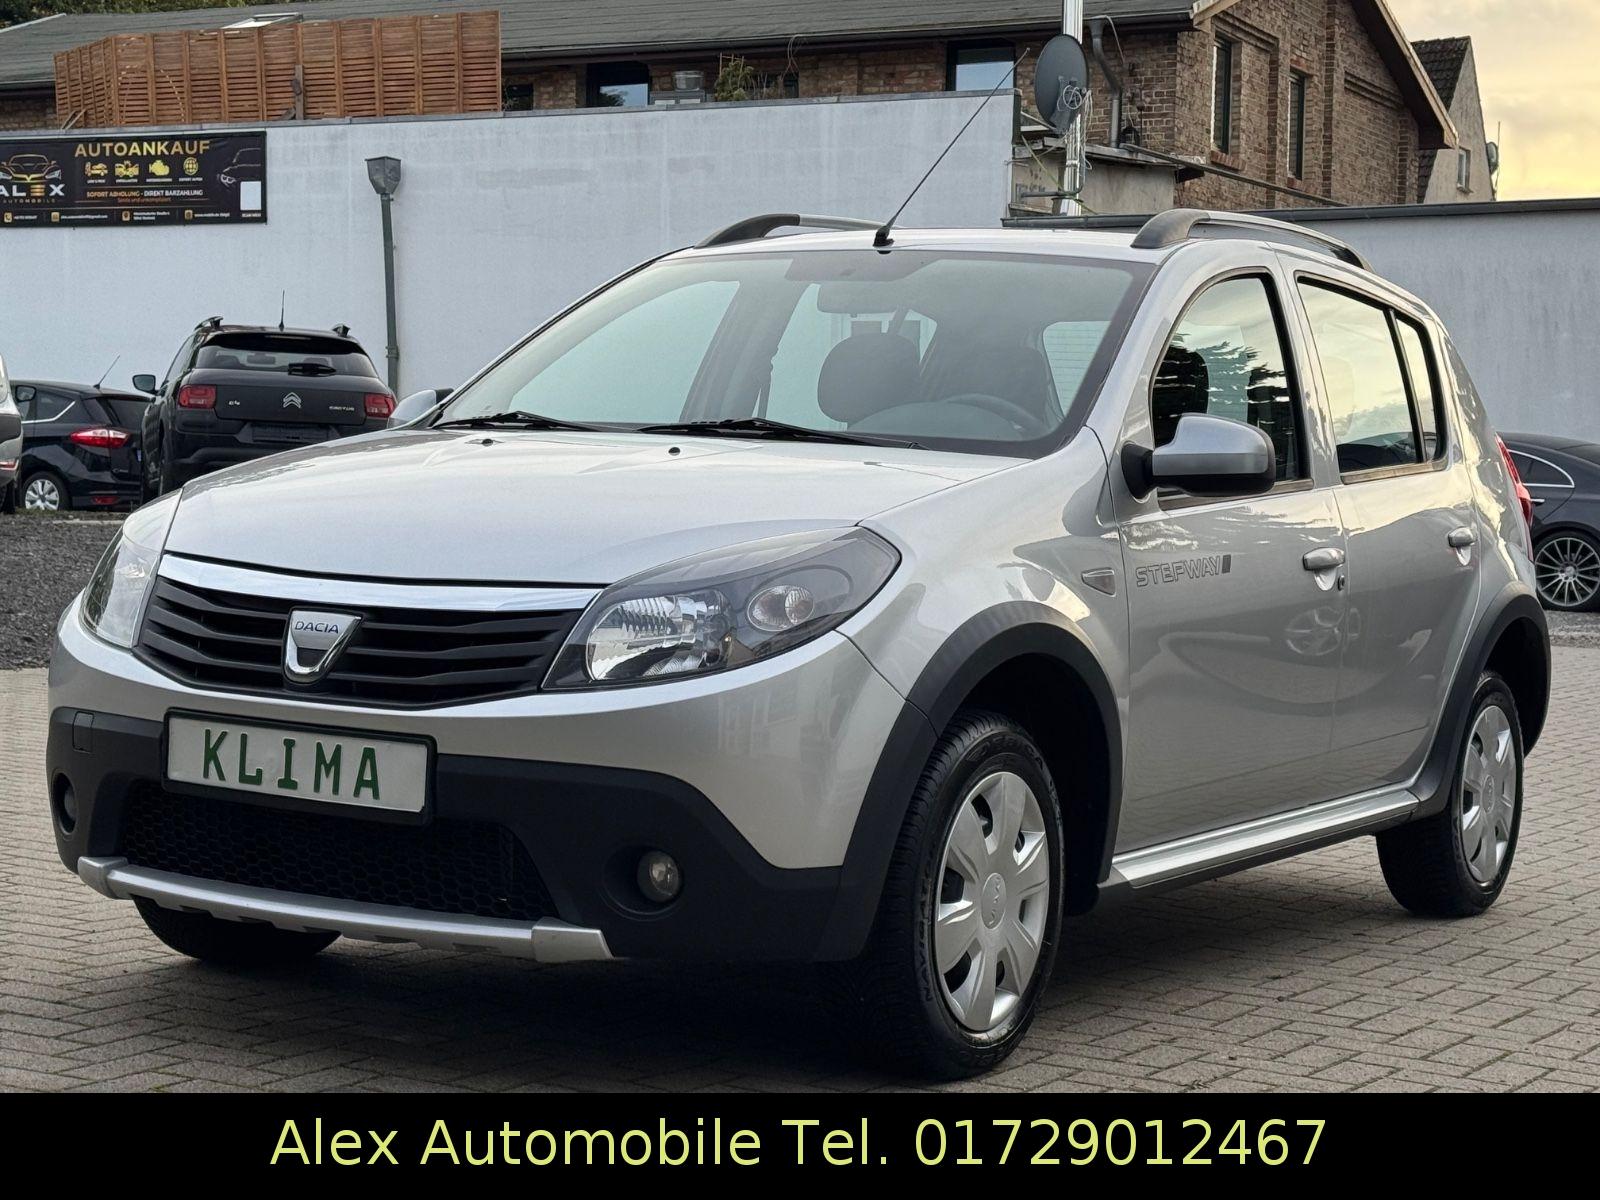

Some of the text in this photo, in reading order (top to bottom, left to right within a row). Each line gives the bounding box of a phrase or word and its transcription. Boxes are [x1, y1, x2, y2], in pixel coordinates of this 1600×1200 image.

[75, 140, 210, 157] AUTOANKAUF
[0, 184, 65, 197] ALEX
[1136, 555, 1221, 588] STEPWAY
[294, 620, 340, 635] DACIA
[203, 729, 380, 800] KLIMA
